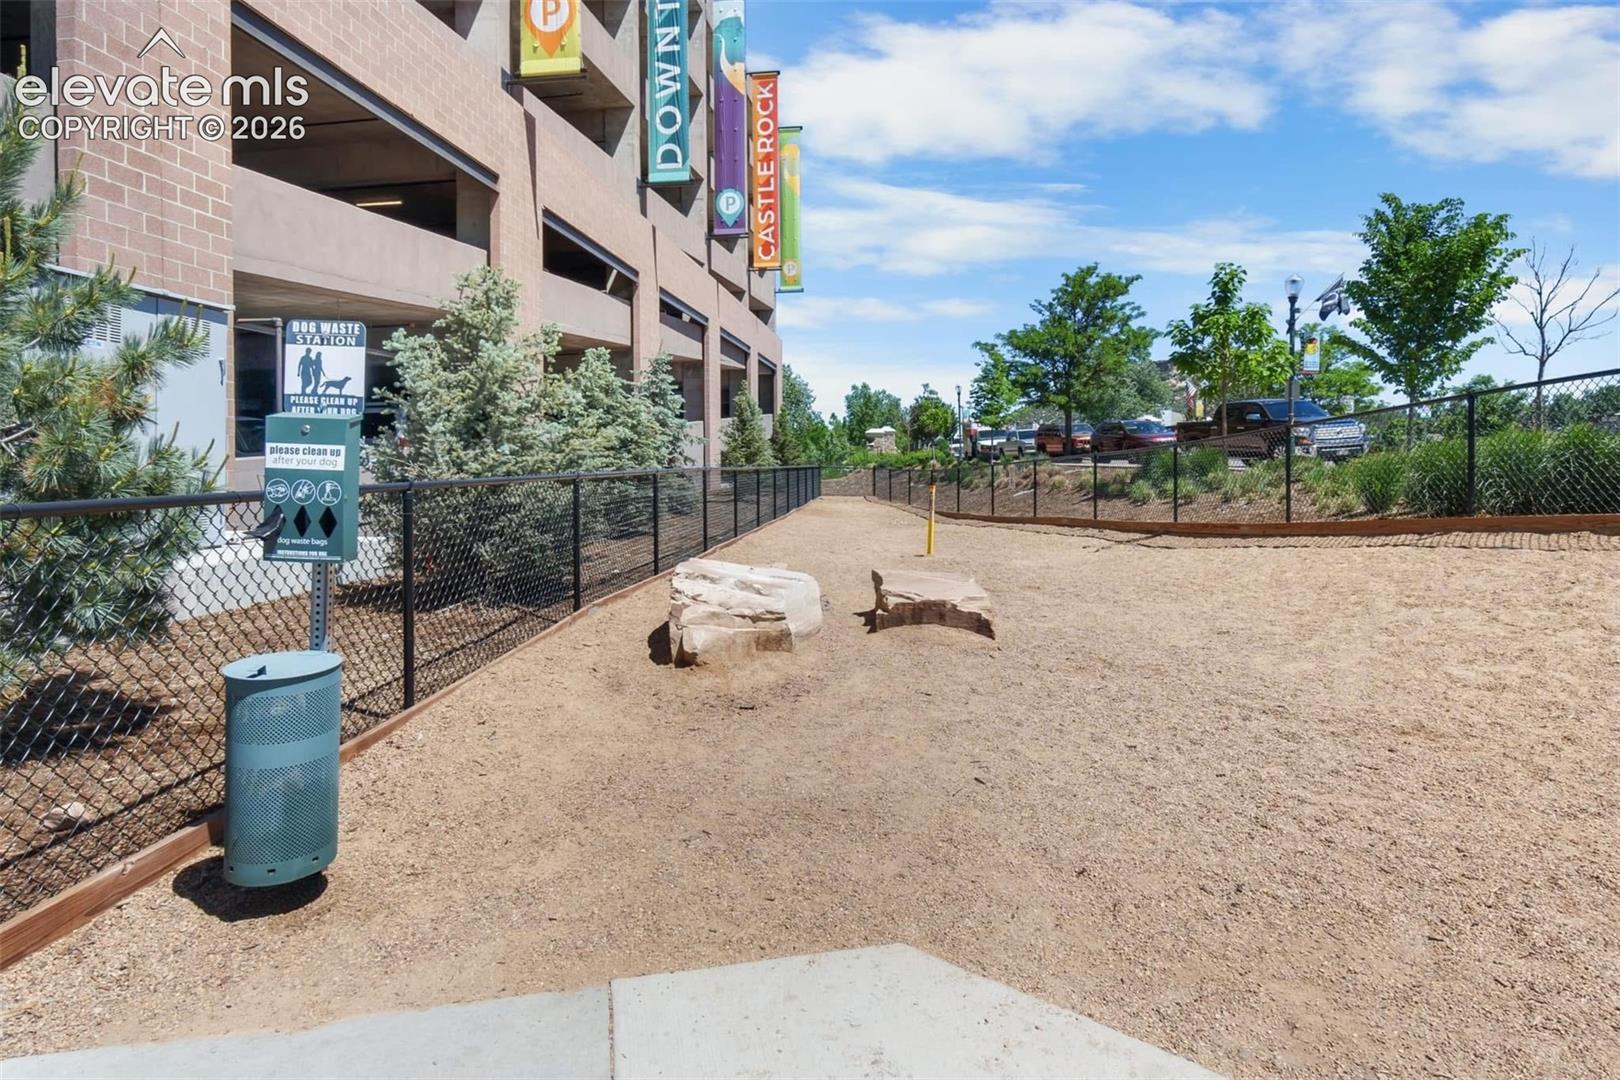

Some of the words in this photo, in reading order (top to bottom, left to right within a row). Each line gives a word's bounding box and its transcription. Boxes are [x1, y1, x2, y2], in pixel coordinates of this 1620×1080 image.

[543, 0, 560, 26] P
[757, 82, 774, 153] ROCK
[725, 196, 736, 211] P
[758, 160, 775, 261] CASTLE
[292, 321, 316, 333] DOG
[320, 322, 360, 334] WASTE
[295, 334, 356, 346] STATION
[290, 395, 319, 404] PLEASE
[321, 396, 345, 405] CLEAN
[347, 398, 358, 406] UP
[270, 445, 300, 455] please
[302, 446, 328, 456] clean
[330, 448, 341, 457] up
[272, 456, 294, 464] after
[296, 458, 317, 466] your
[319, 458, 338, 467] dog
[277, 536, 290, 546] dog
[311, 537, 328, 547] bags
